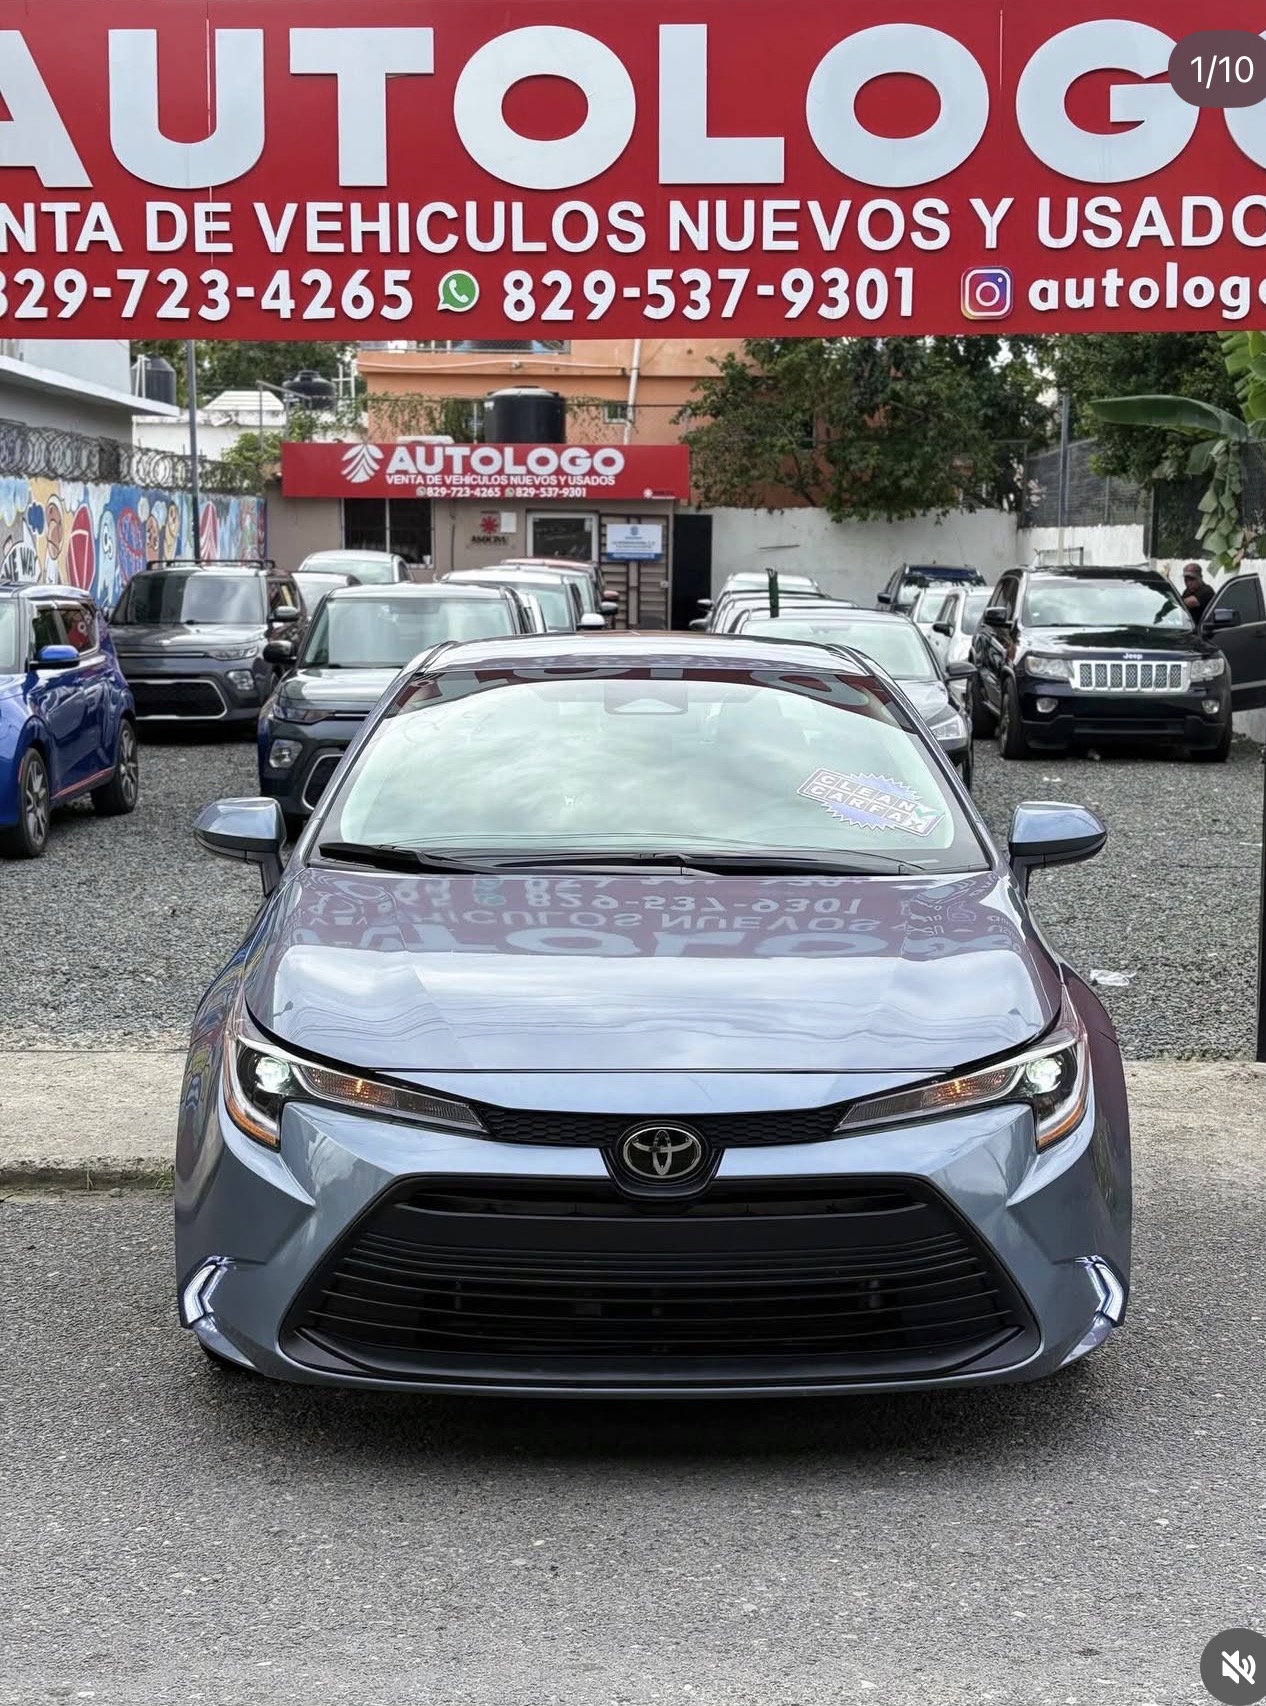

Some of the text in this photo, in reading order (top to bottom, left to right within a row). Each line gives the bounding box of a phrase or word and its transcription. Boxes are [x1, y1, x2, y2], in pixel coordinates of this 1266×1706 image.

[0, 19, 1266, 190] AUTOLOG
[146, 201, 234, 253] DE
[253, 200, 646, 254] VEHICULOS
[669, 198, 951, 252] NUEVOS
[969, 197, 1014, 250] Y
[1037, 195, 1266, 249] USADO
[0, 261, 1266, 322] 29-723-4265 829-537-9301 autolog
[385, 472, 615, 485] VENTA DE VEHÍCULOS NUEVOS Y USADOS
[386, 446, 625, 475] AUTOLOGO
[426, 487, 586, 497] 829-723-4265 829-537-9301
[1122, 652, 1143, 660] Jeep
[810, 785, 923, 831] CARFAX
[819, 775, 918, 812] CLEAN
